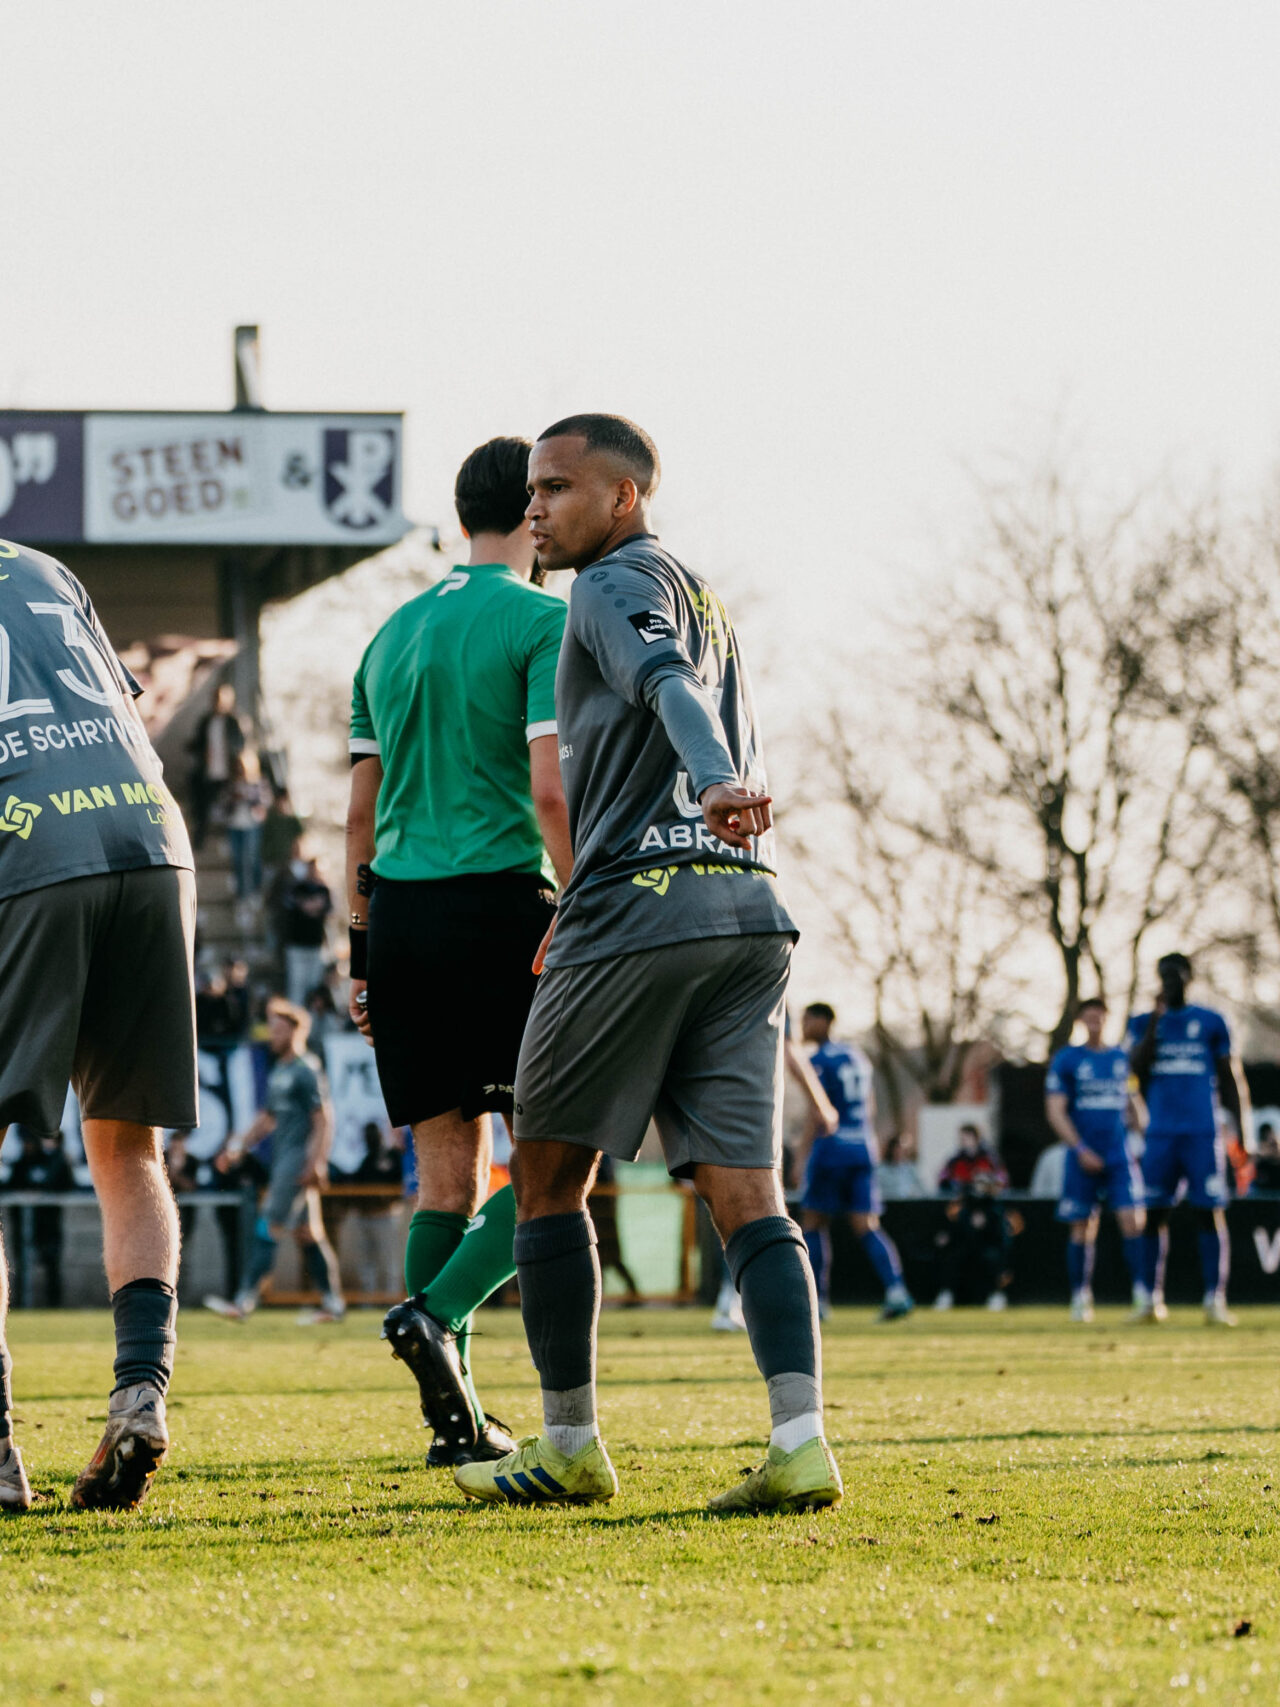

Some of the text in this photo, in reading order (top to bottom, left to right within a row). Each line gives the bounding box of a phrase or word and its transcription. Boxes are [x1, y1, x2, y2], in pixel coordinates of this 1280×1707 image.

[112, 437, 243, 484] STEEN
[113, 480, 223, 521] GOED
[49, 785, 117, 816] VAN
